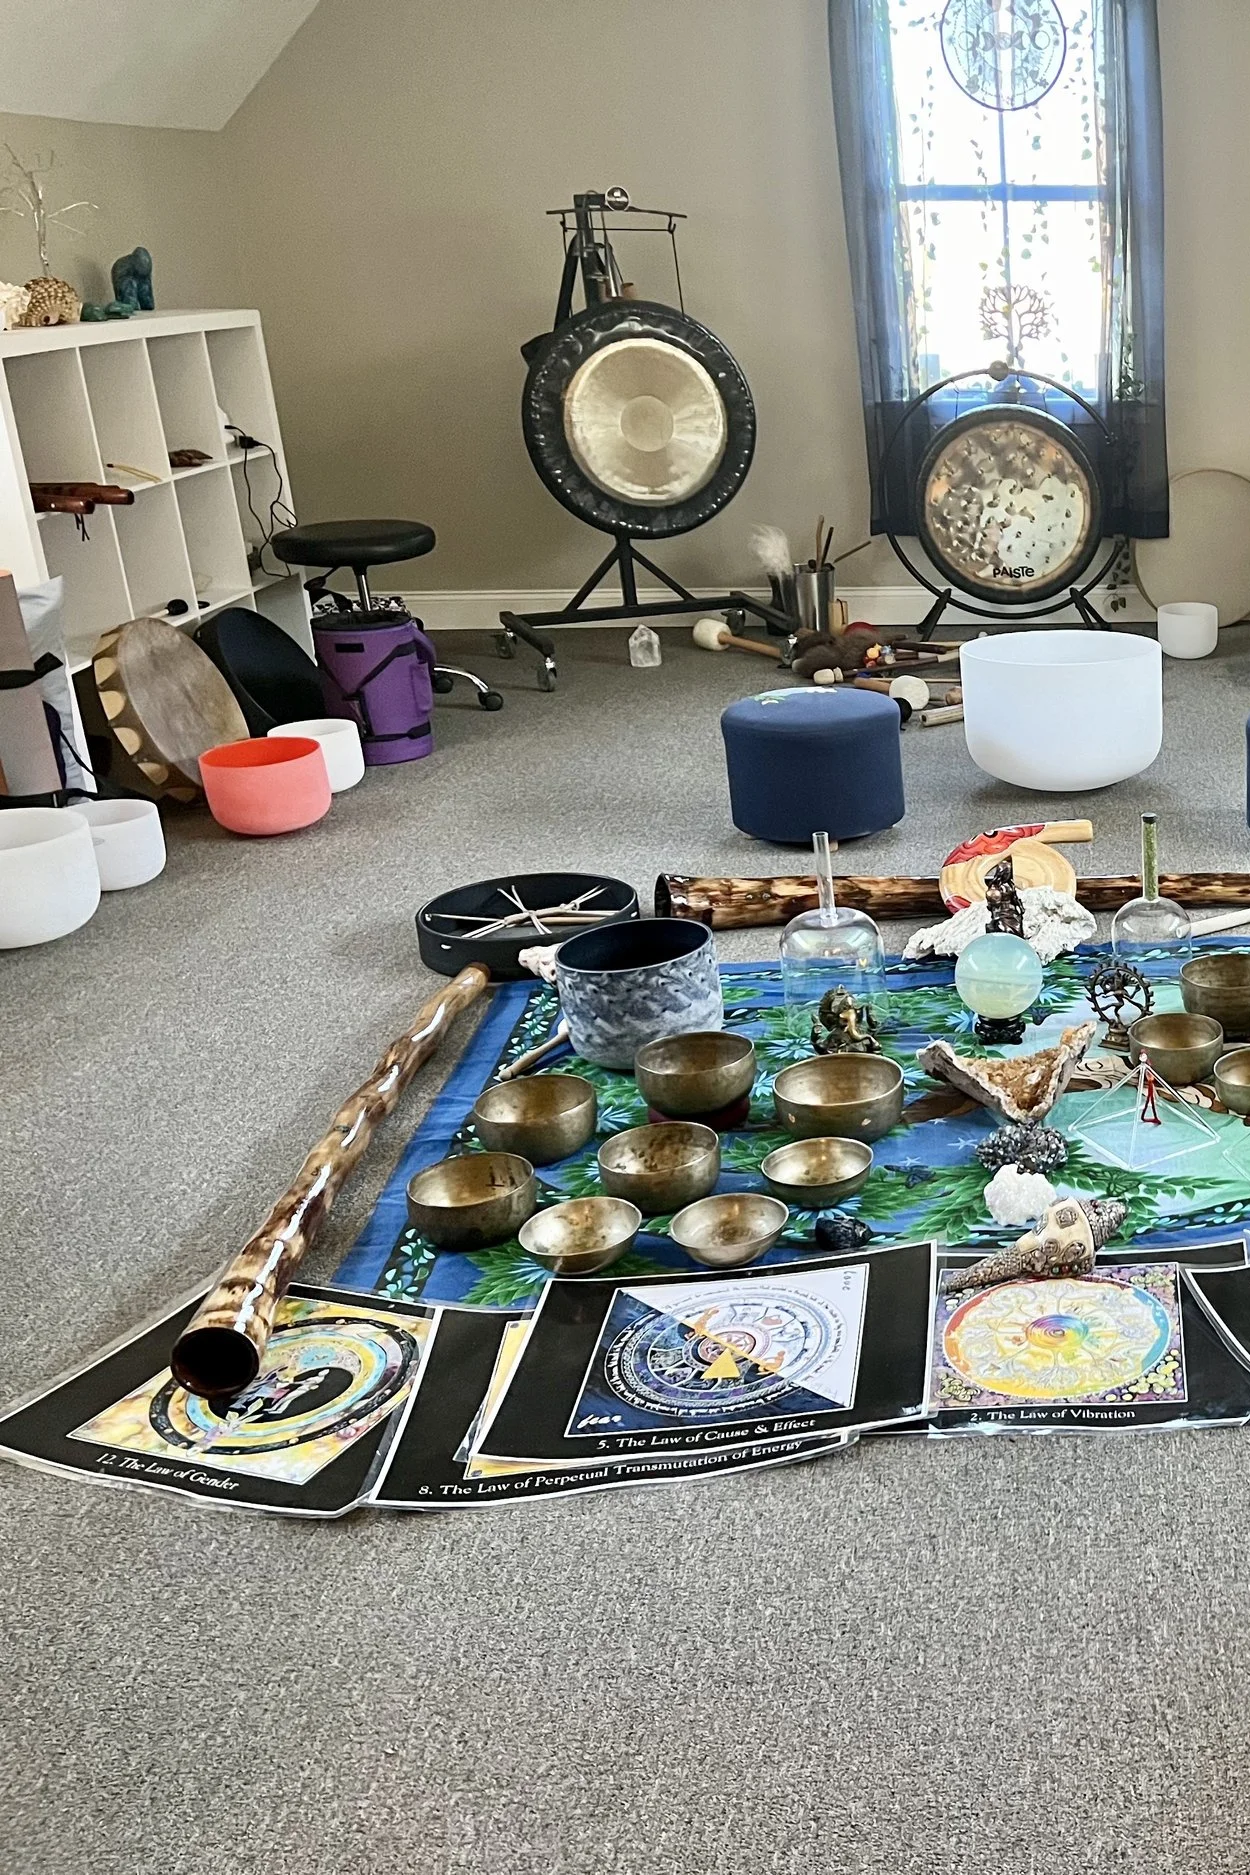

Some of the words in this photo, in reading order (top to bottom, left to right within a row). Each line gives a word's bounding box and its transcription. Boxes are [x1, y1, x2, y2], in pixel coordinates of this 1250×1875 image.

[970, 1412, 982, 1421] 2.
[987, 1411, 1016, 1420] The
[1020, 1410, 1048, 1419] Law
[1052, 1409, 1068, 1418] of
[1070, 1408, 1136, 1419] Vibration
[597, 1439, 610, 1450] 5.
[616, 1437, 646, 1448] The
[650, 1435, 682, 1445] Law
[685, 1431, 703, 1443] of
[704, 1428, 749, 1441] Cause
[754, 1423, 769, 1434] &
[773, 1419, 816, 1432] Effect
[96, 1453, 114, 1466] 12.
[118, 1457, 145, 1471] The
[145, 1462, 174, 1475] Law
[173, 1468, 191, 1479] of
[189, 1469, 240, 1490] Gender
[418, 1485, 433, 1495] 8.
[440, 1485, 472, 1495] The
[477, 1483, 510, 1494] Law
[514, 1477, 534, 1490] of
[534, 1466, 609, 1487] Perpetual
[613, 1454, 728, 1475] Transmutation
[732, 1448, 749, 1461] of
[751, 1440, 803, 1457] Energy
